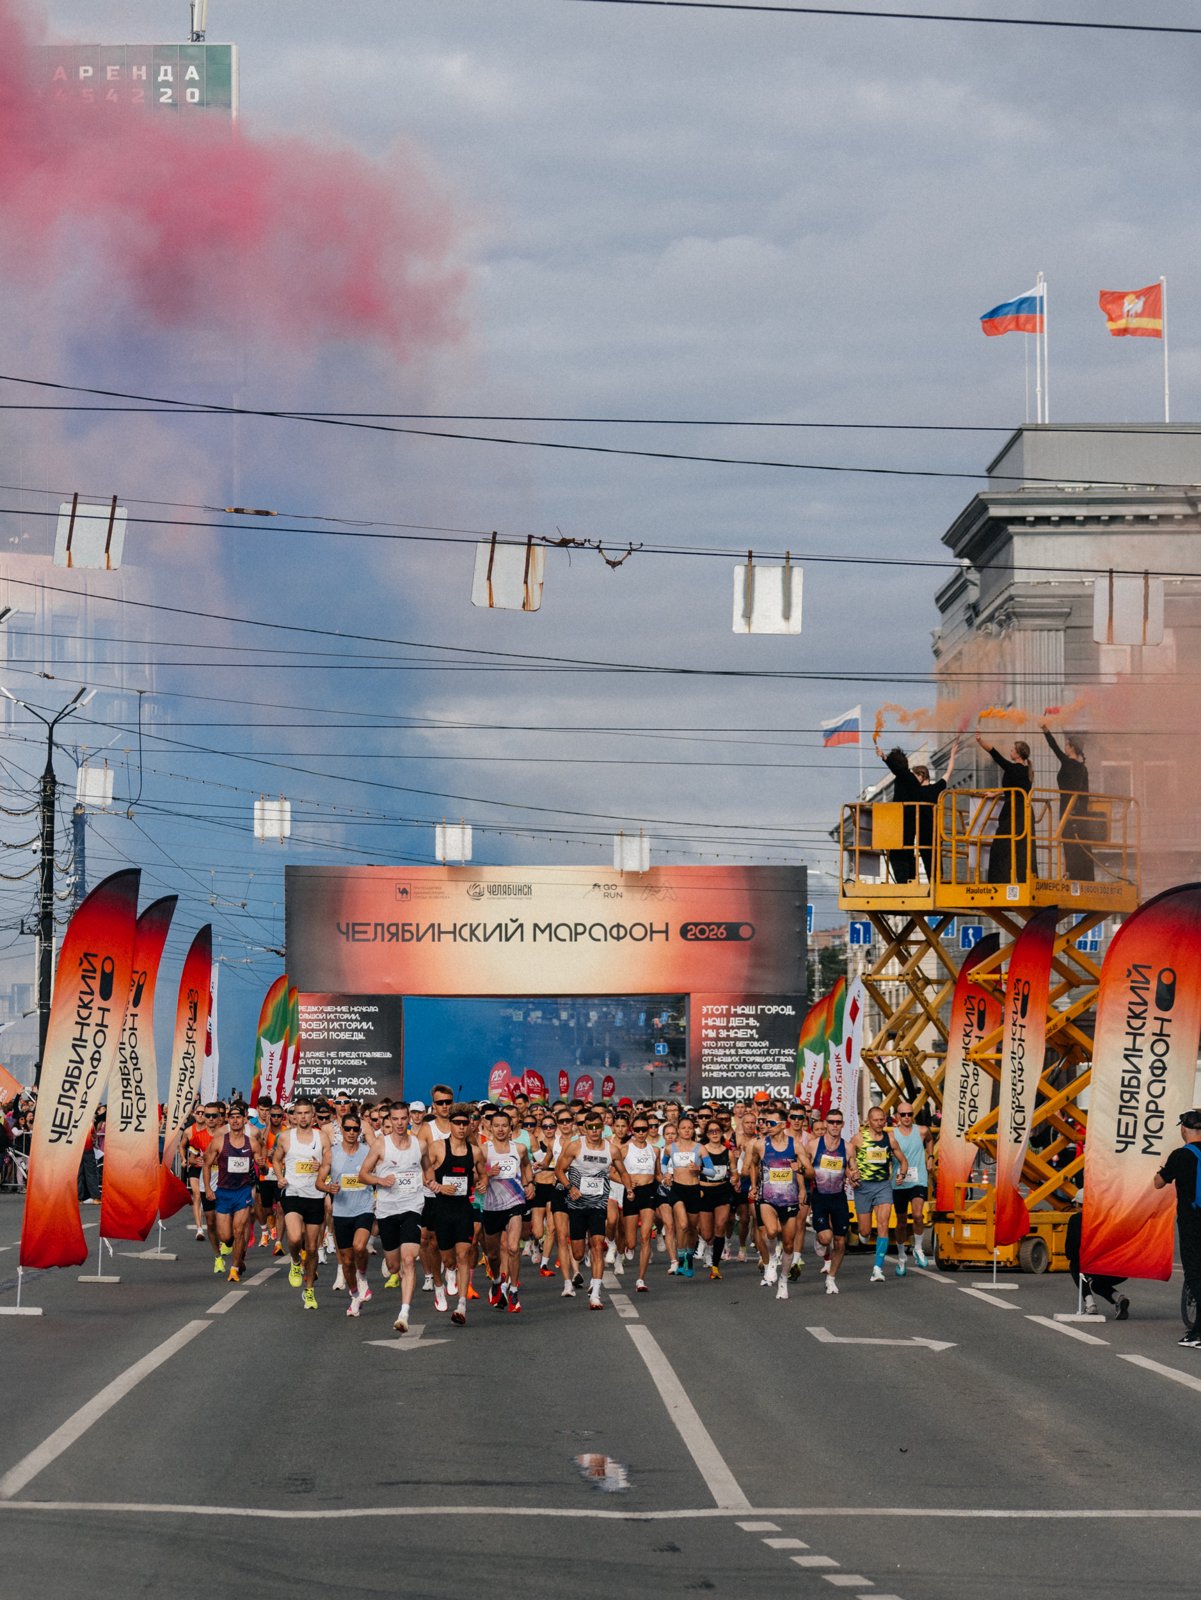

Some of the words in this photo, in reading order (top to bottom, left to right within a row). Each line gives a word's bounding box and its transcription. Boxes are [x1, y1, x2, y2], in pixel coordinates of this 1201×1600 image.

[53, 66, 200, 82] АРЕНДА
[336, 918, 524, 942] ЧЕЛЯБИНСКИЙ
[532, 922, 669, 942] МАРАФОН
[686, 925, 727, 939] 2026
[702, 1006, 728, 1014] ЭТОТ
[731, 1006, 755, 1014] НАШ
[758, 1006, 795, 1015] ГОРОД,
[702, 1018, 726, 1026] НАШ
[729, 1018, 759, 1027] ДЕНЬ,
[329, 1022, 374, 1030] ИСТОРИИ,
[702, 1029, 716, 1038] МЫ
[719, 1029, 758, 1038] ЗНАЕМ,
[48, 952, 98, 1144] ЧЕЛЯБИНСКИЙ
[1114, 964, 1152, 1154] ЧЕЛЯБИНСКИЙ
[128, 1014, 147, 1132] МАРАФОН
[266, 1050, 275, 1081] Банк
[834, 1052, 843, 1084] Банк
[1141, 1016, 1172, 1156] МАРАФОН
